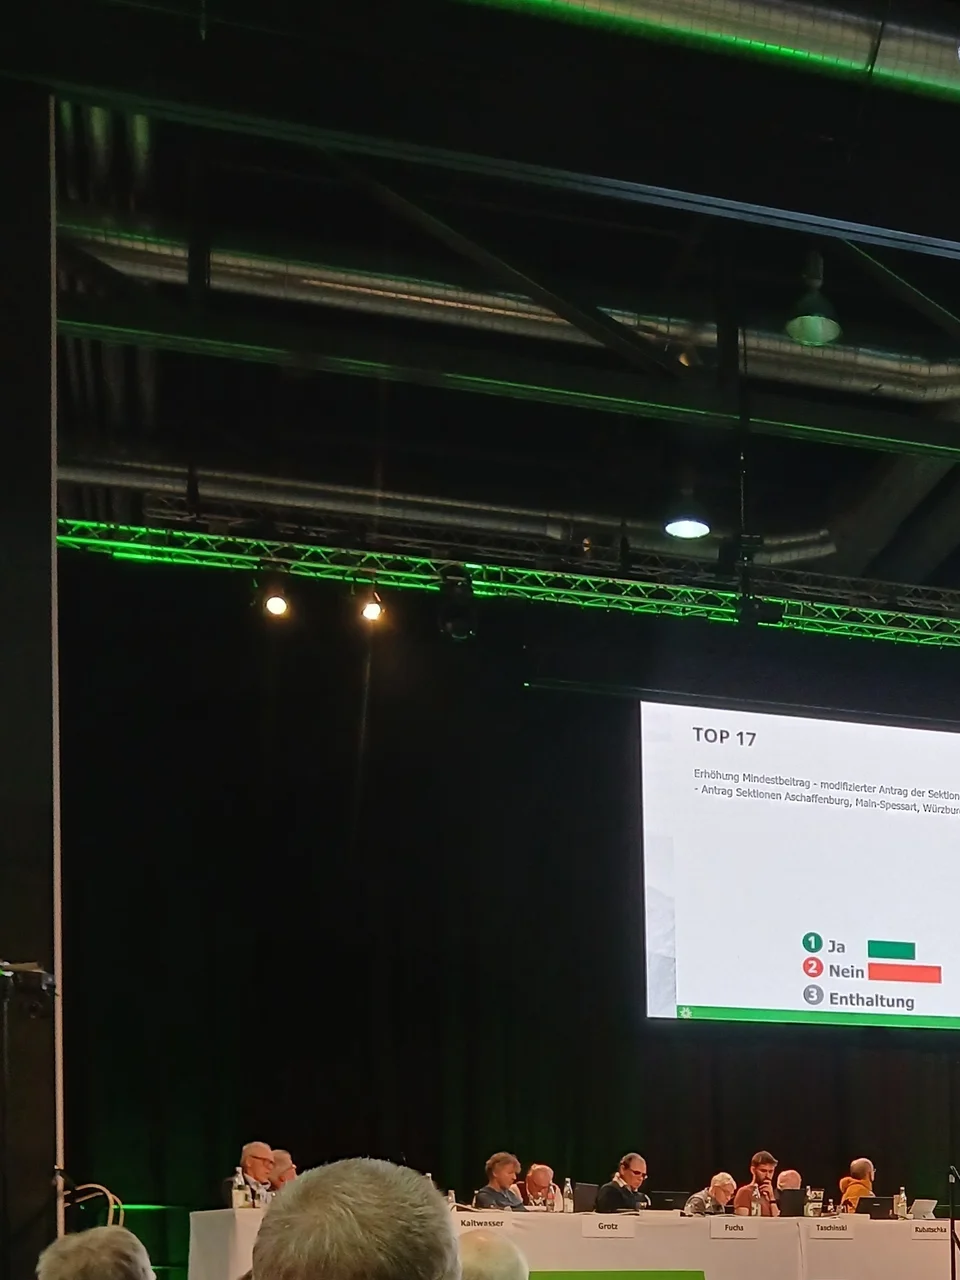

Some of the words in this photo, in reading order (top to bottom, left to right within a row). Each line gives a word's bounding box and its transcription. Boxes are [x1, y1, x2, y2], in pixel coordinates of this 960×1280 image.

[692, 727, 730, 744] TOP
[736, 732, 757, 746] 17
[694, 768, 740, 784] Erhöhung
[742, 772, 810, 789] Mindestbeitrag
[820, 780, 876, 793] modifizierter
[879, 784, 908, 798] Antrag
[910, 786, 926, 797] der
[701, 785, 733, 798] Antrag
[736, 787, 782, 800] Sektionen
[784, 792, 852, 808] Aschaffenburg,
[856, 798, 920, 813] Main-Spessart,
[828, 939, 846, 954] Ja
[807, 960, 818, 975] 2
[829, 964, 865, 981] Nein
[808, 987, 819, 1003] 3
[830, 991, 916, 1012] Enthaltung
[460, 1220, 504, 1228] Kaltwasser
[598, 1222, 618, 1230] Grotz
